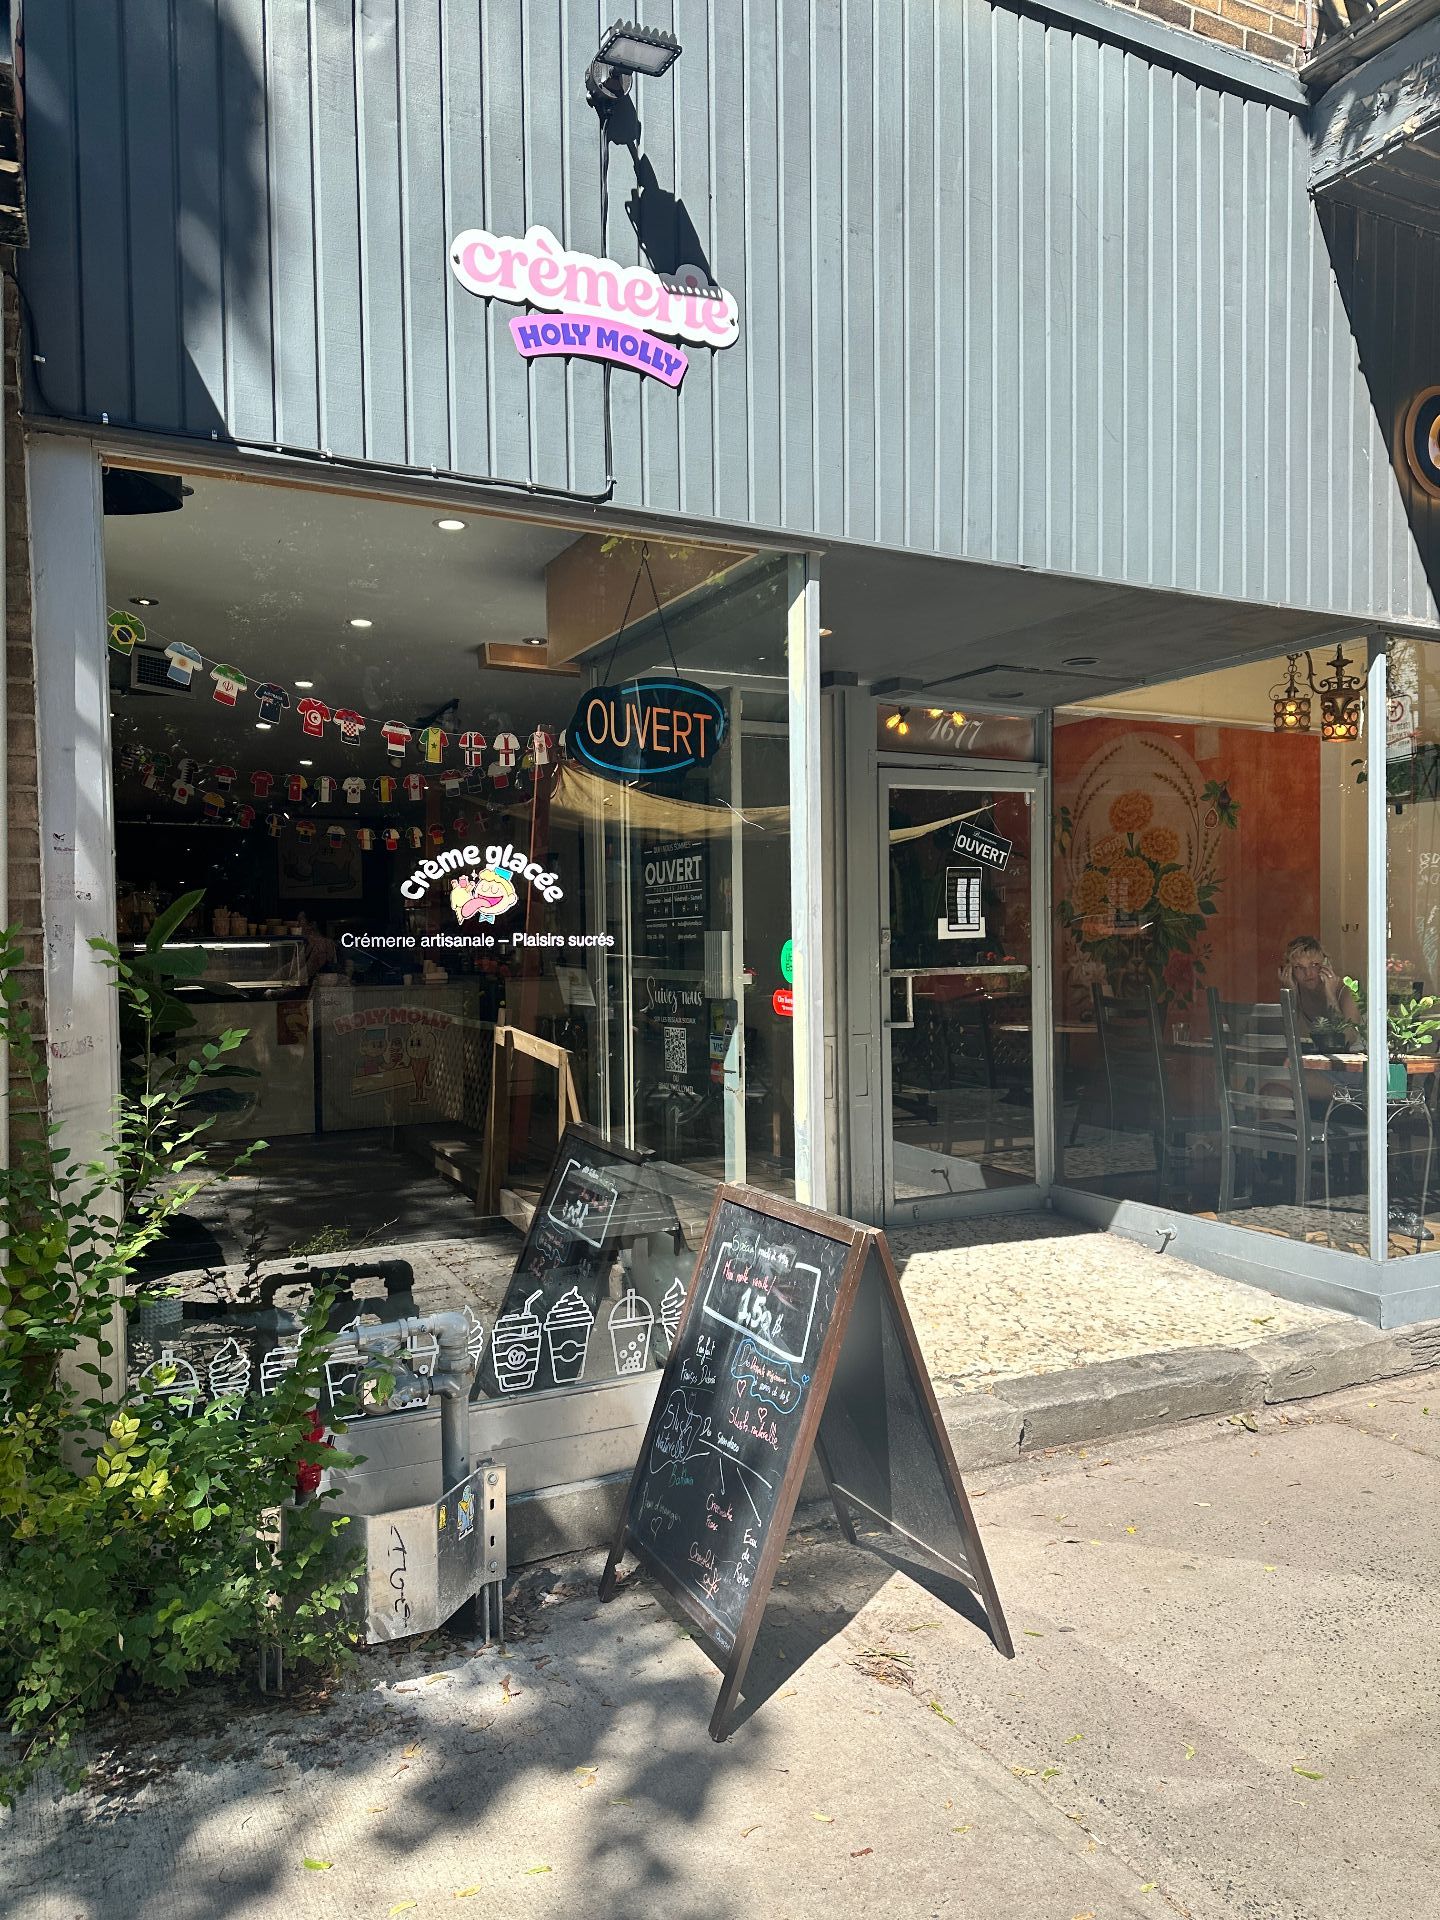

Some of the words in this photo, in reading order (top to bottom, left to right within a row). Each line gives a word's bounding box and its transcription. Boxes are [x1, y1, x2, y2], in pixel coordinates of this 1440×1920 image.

[462, 238, 730, 334] crèmerie
[518, 323, 591, 349] HOLY
[597, 328, 683, 377] MOLLY
[586, 698, 713, 758] OUVERT
[927, 715, 984, 751] 1677
[957, 834, 1008, 864] OUVERT
[400, 845, 481, 900] crème
[486, 843, 564, 903] glacée
[644, 855, 703, 886] OUVERT
[420, 933, 495, 948] artisanale
[512, 933, 565, 948] Plaisirs
[568, 933, 615, 948] sucrés
[333, 1008, 389, 1036] HOLY
[390, 1007, 452, 1033] MOLLY
